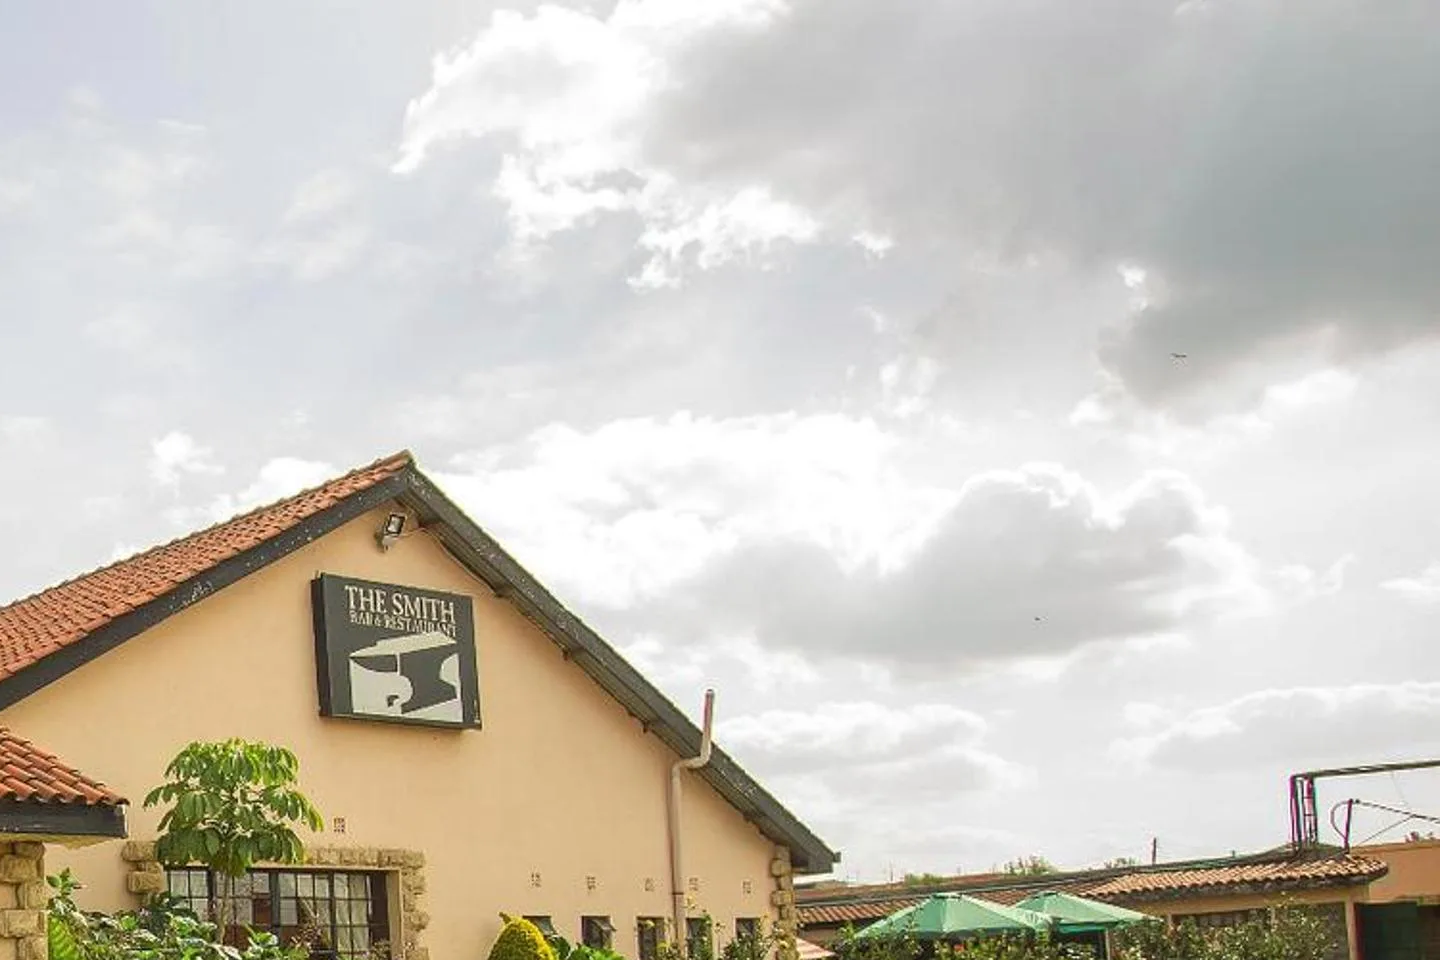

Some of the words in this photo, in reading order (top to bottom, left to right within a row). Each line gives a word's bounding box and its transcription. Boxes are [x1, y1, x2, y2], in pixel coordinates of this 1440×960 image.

[345, 585, 387, 613] THE
[392, 592, 456, 624] SMITH
[384, 615, 457, 638] RESTAURANT
